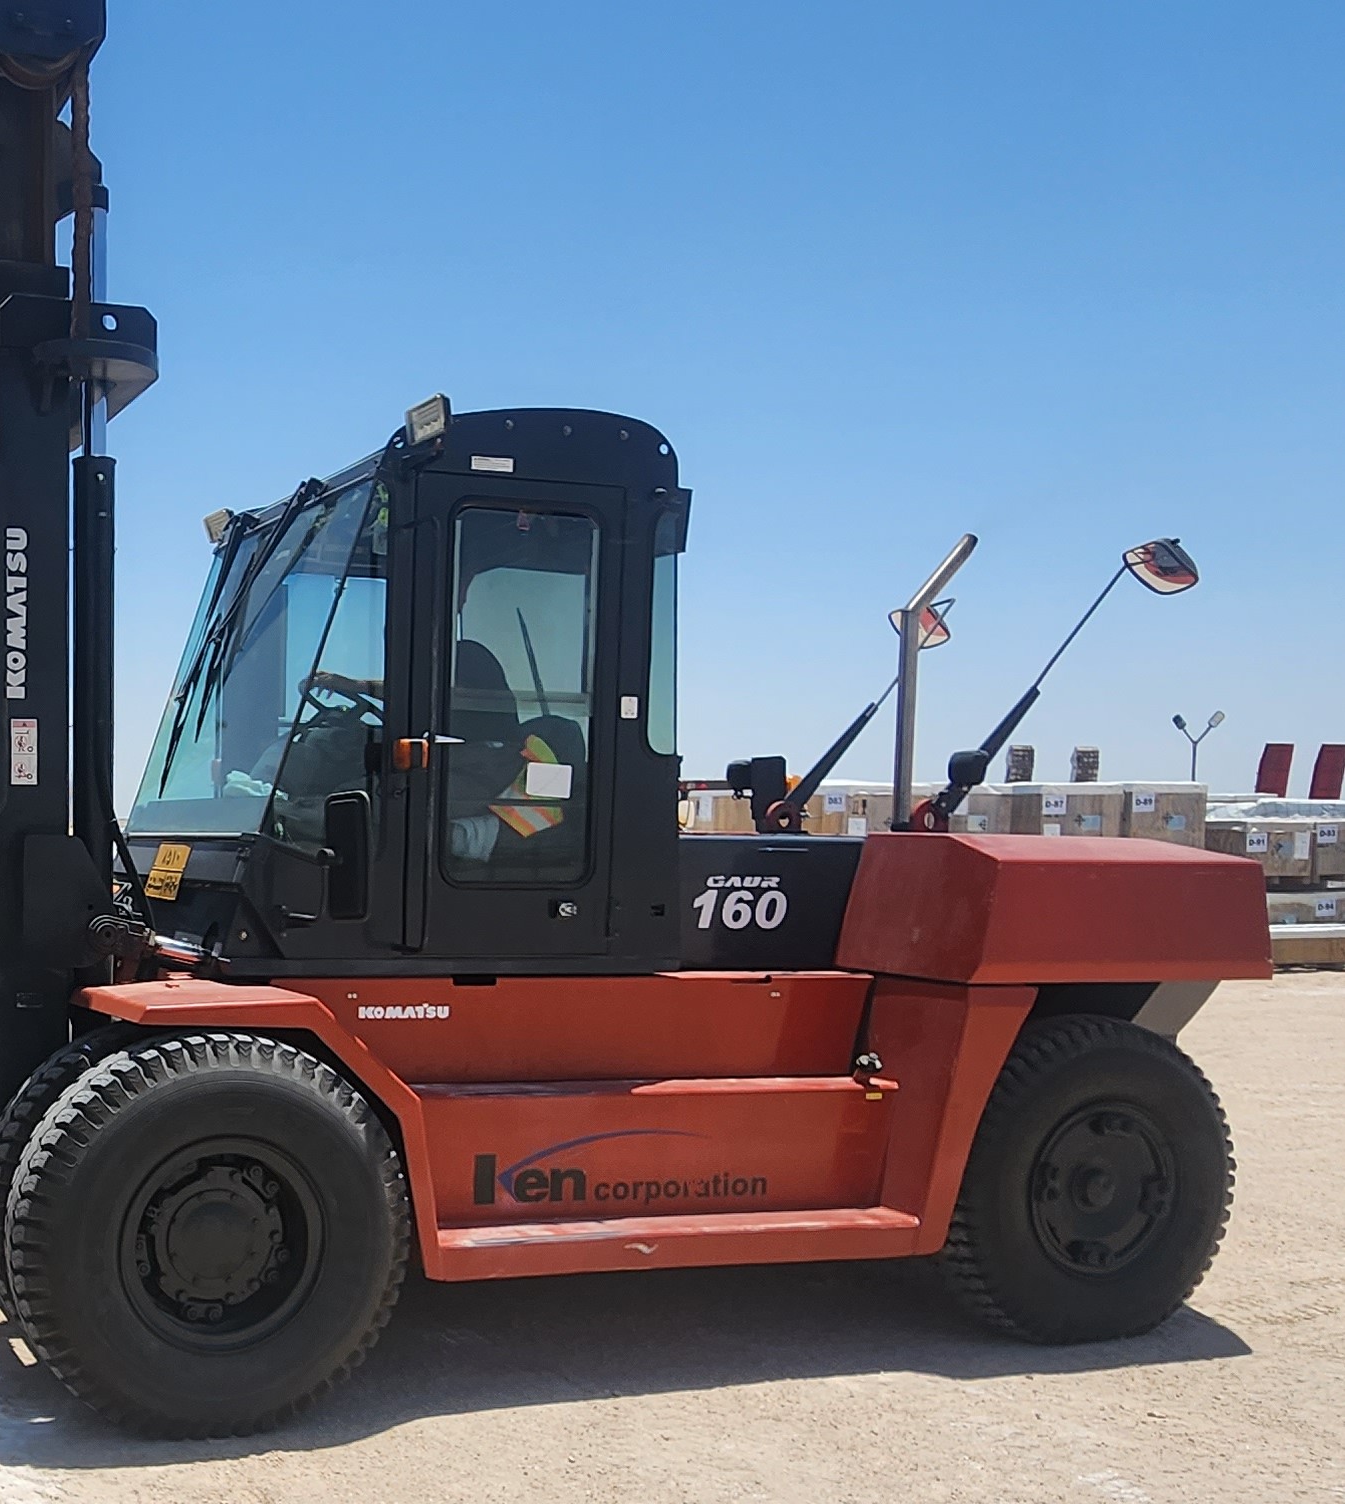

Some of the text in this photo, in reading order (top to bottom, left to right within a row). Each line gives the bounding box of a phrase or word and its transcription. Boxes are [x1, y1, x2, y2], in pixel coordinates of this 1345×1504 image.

[6, 526, 29, 699] KOMATSU
[706, 875, 781, 888] GAUR
[692, 889, 788, 929] 160
[358, 1005, 450, 1019] KOMATSU
